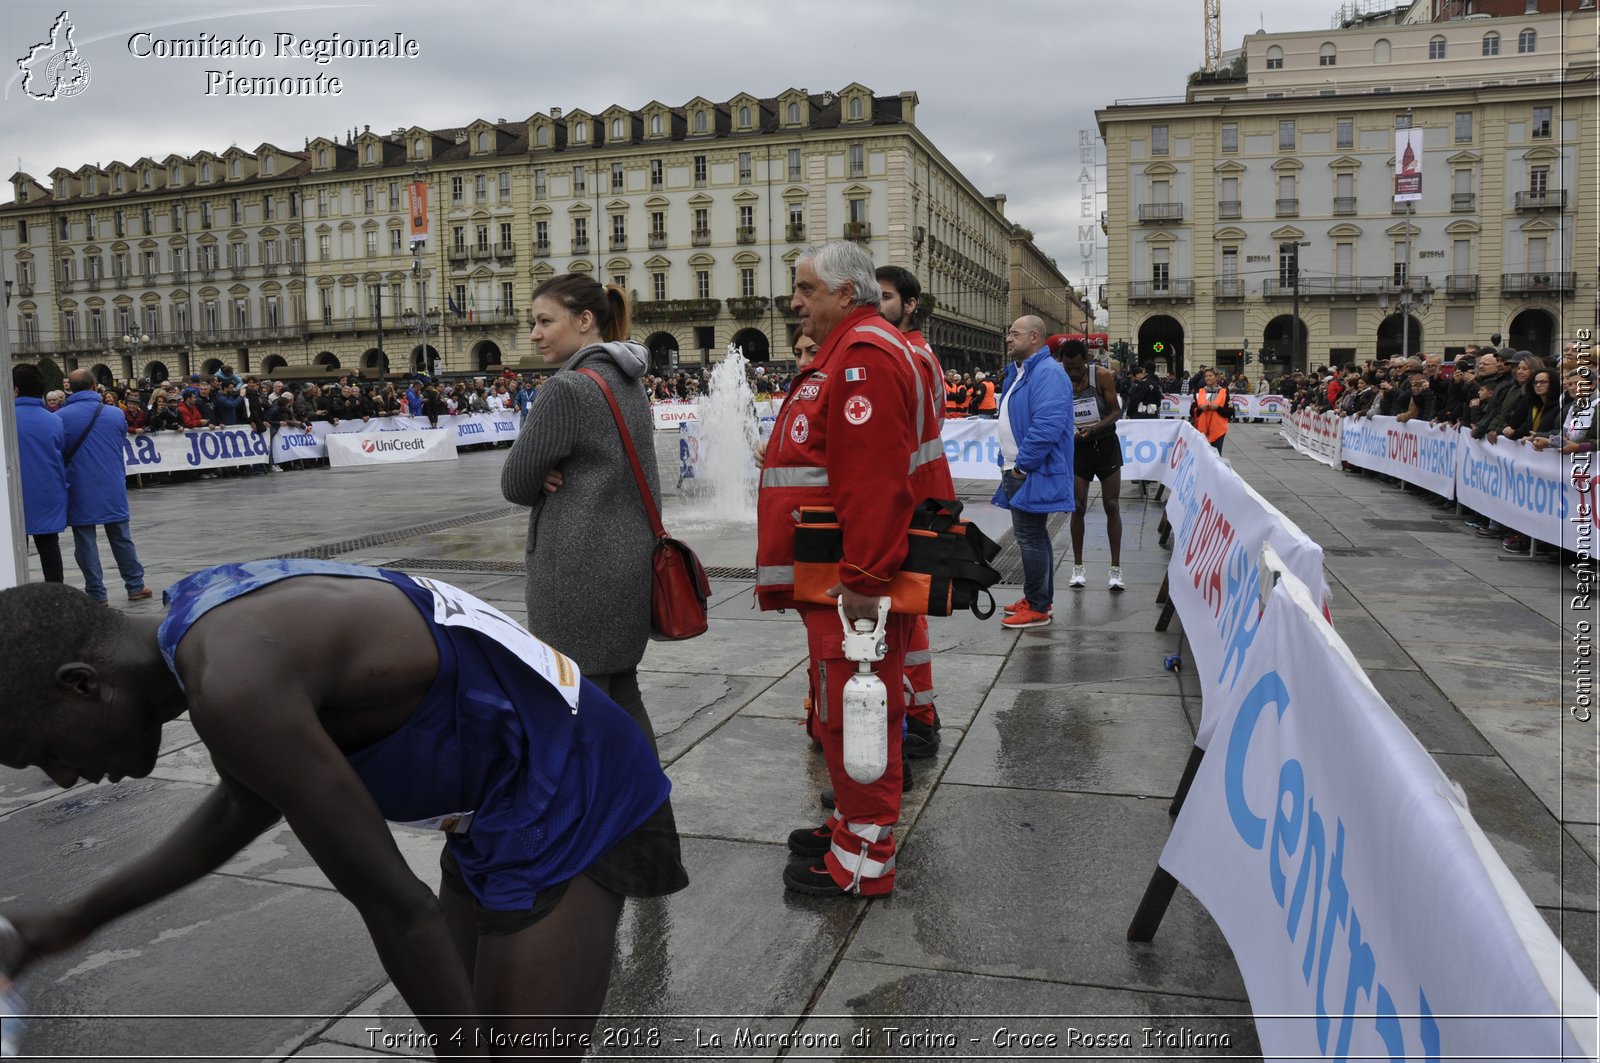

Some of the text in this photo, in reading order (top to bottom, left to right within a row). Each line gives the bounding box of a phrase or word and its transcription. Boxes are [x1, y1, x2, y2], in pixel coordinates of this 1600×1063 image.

[1078, 129, 1094, 218] REALE
[661, 412, 697, 421] GIMA
[375, 438, 425, 451] UniCredit
[1388, 430, 1418, 467] TOYOTA
[1463, 447, 1502, 498] Central
[1504, 457, 1569, 519] Motors
